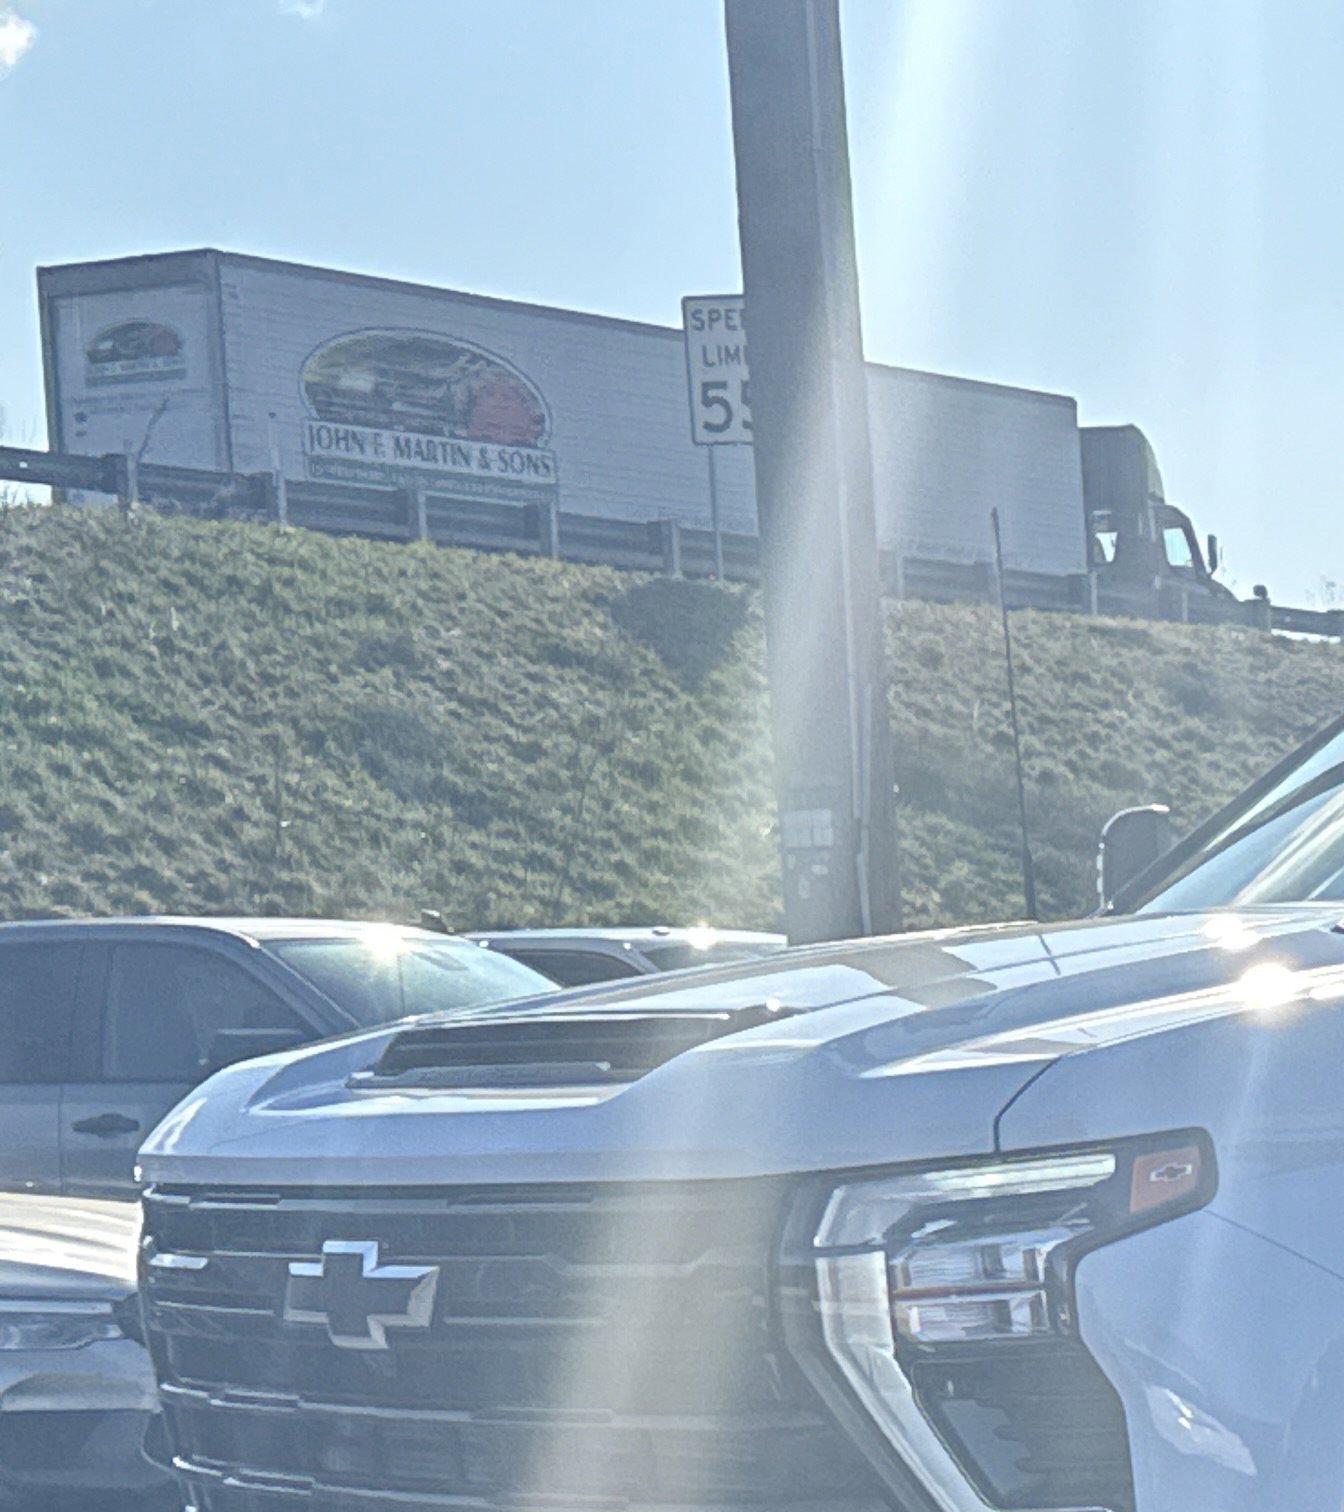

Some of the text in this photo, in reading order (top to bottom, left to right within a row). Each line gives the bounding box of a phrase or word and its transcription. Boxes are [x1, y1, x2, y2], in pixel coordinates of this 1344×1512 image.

[691, 308, 745, 331] SPE
[308, 424, 366, 455] JOHN
[392, 434, 471, 469] MARTIN
[477, 445, 493, 471] &
[496, 448, 551, 477] SONS
